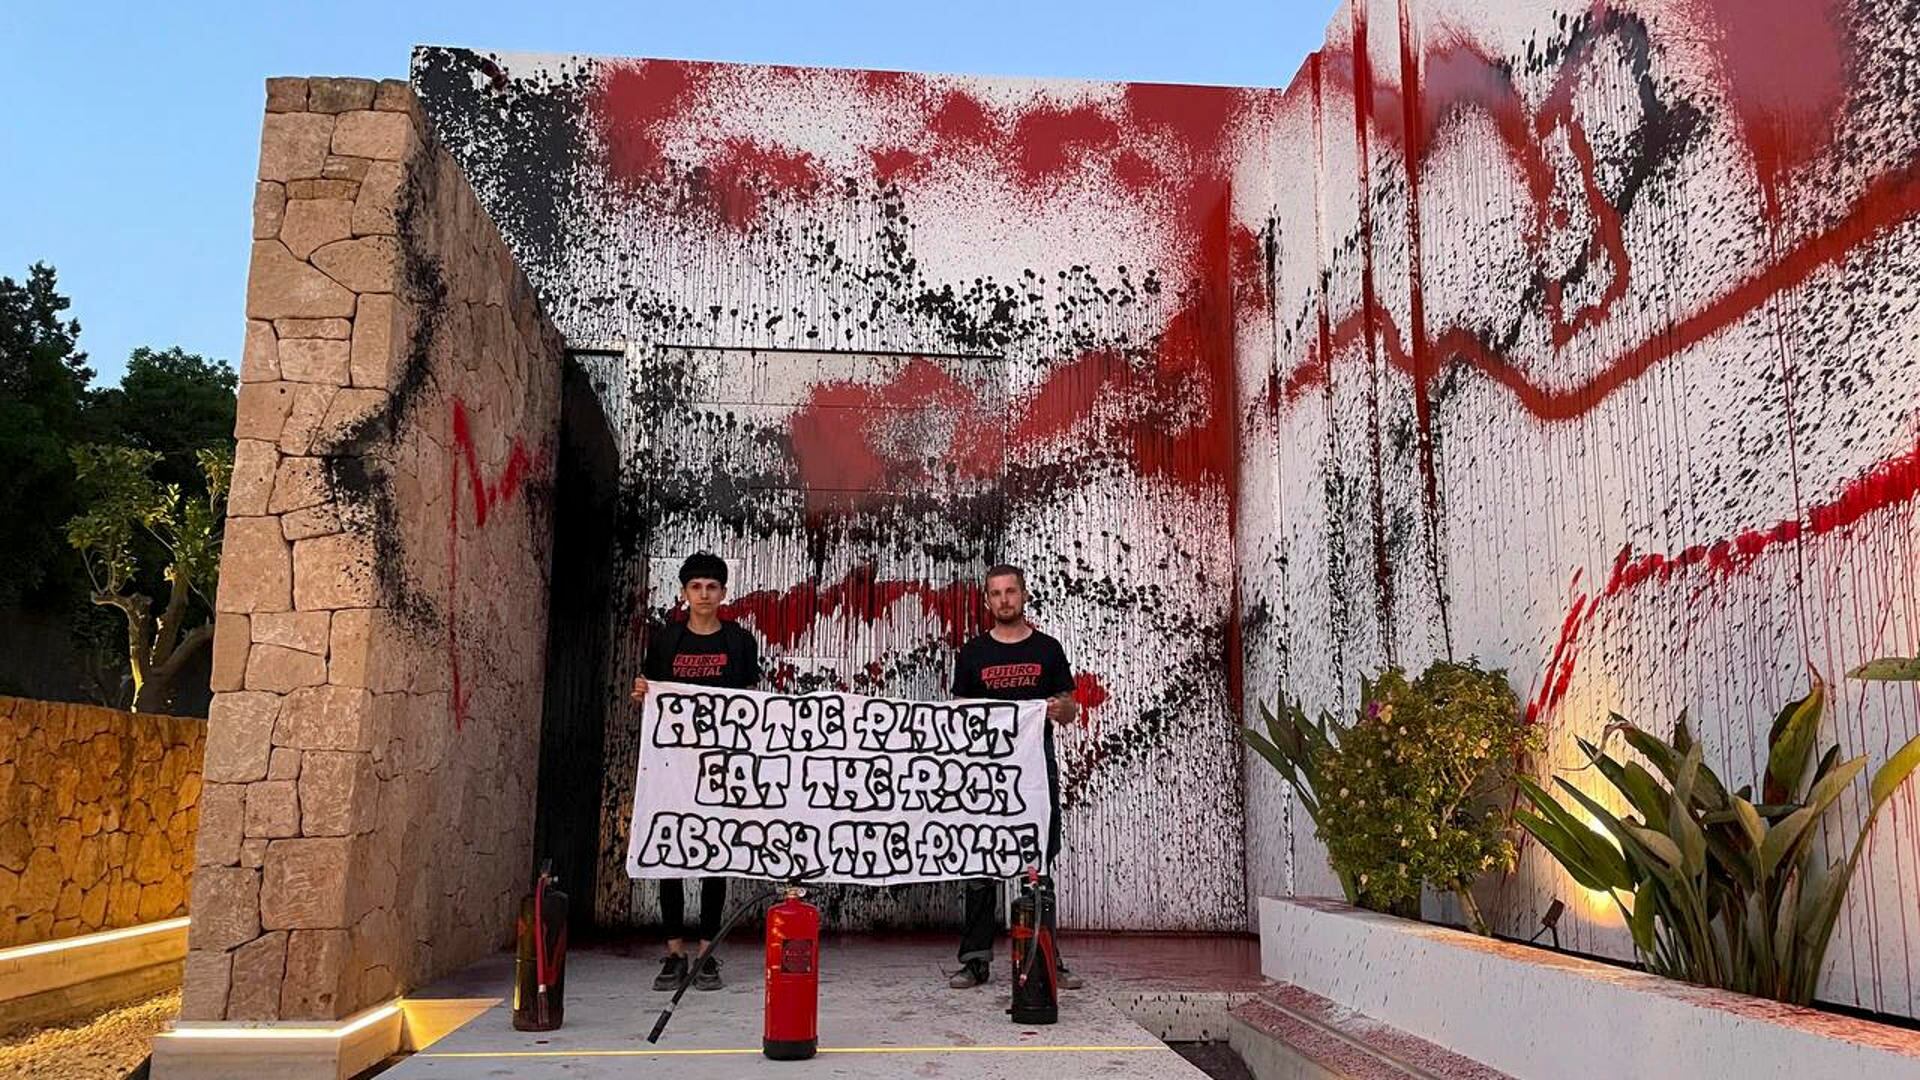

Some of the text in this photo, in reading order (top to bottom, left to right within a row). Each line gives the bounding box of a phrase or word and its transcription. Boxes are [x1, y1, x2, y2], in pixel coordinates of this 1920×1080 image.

[985, 676, 1037, 690] VEGETAL
[986, 664, 1036, 679] FUTURO
[653, 693, 1019, 759] HELP THE PLANET
[695, 751, 790, 808] EAT
[803, 756, 895, 811] THE
[829, 821, 913, 878] THE
[916, 821, 1042, 878] POLICE
